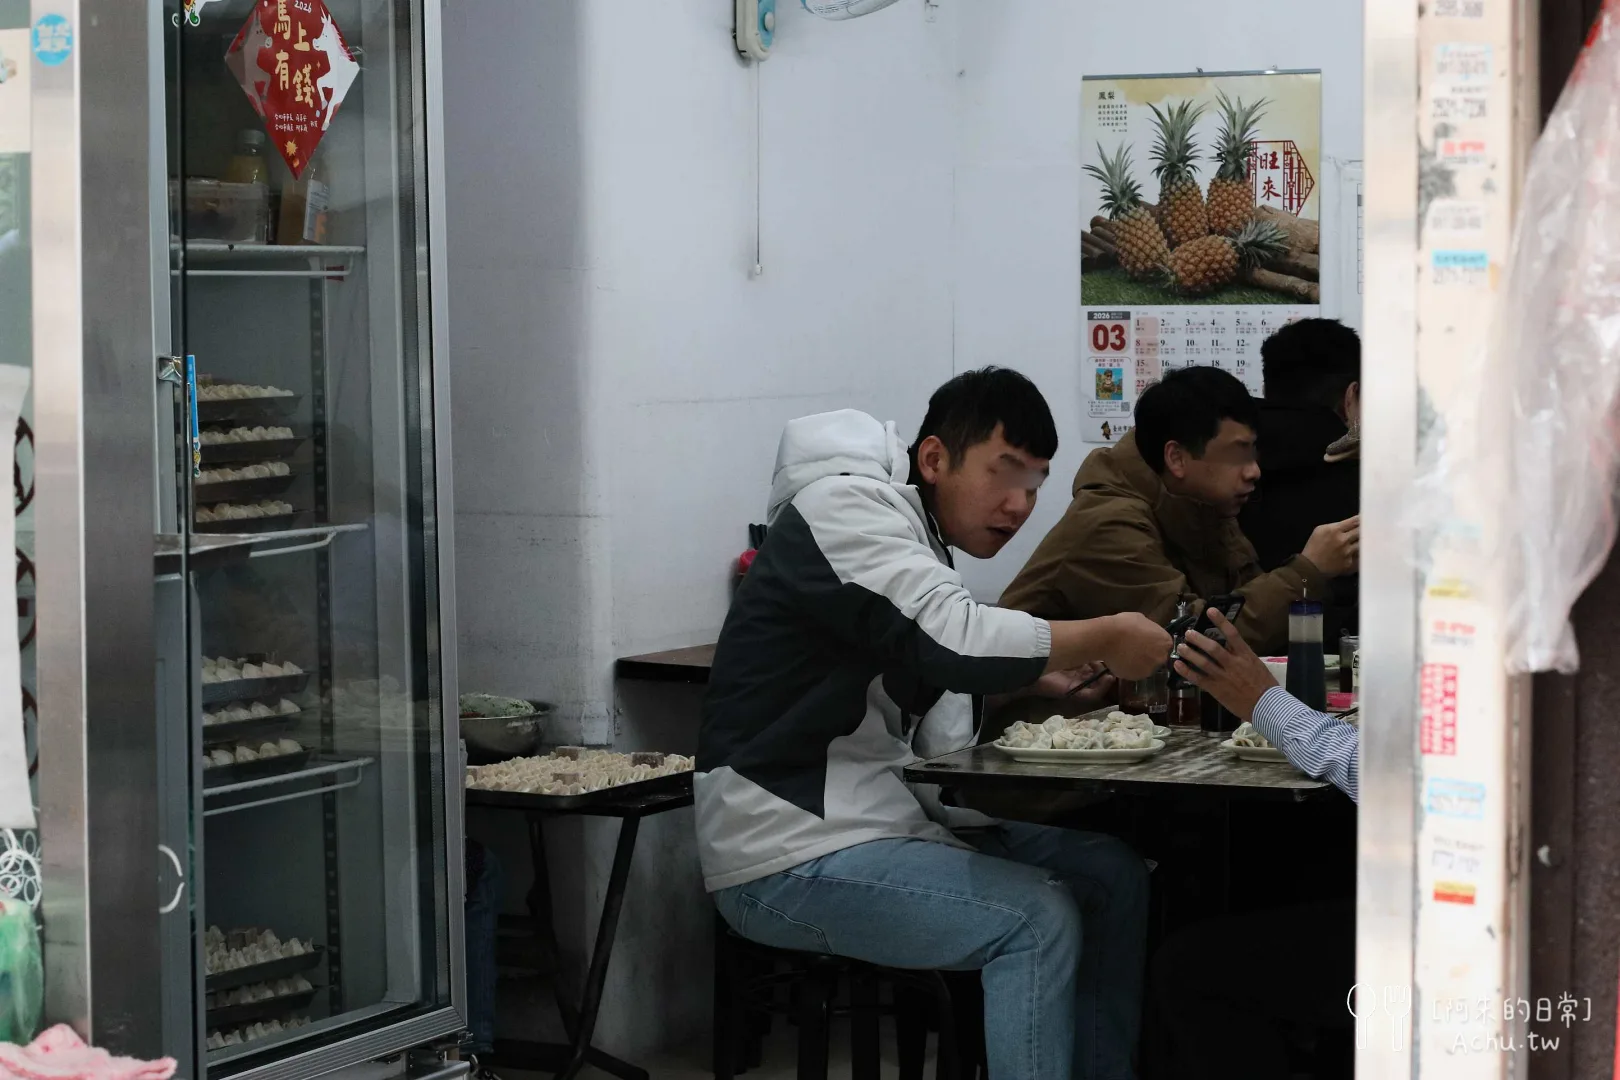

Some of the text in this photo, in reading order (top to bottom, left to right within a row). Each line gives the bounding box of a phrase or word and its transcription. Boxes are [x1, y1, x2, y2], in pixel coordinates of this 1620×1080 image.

[273, 0, 311, 51] 馬上
[294, 0, 312, 14] 2026
[275, 49, 316, 108] 有錢
[1259, 151, 1282, 201] 旺來
[1093, 324, 1126, 351] 03
